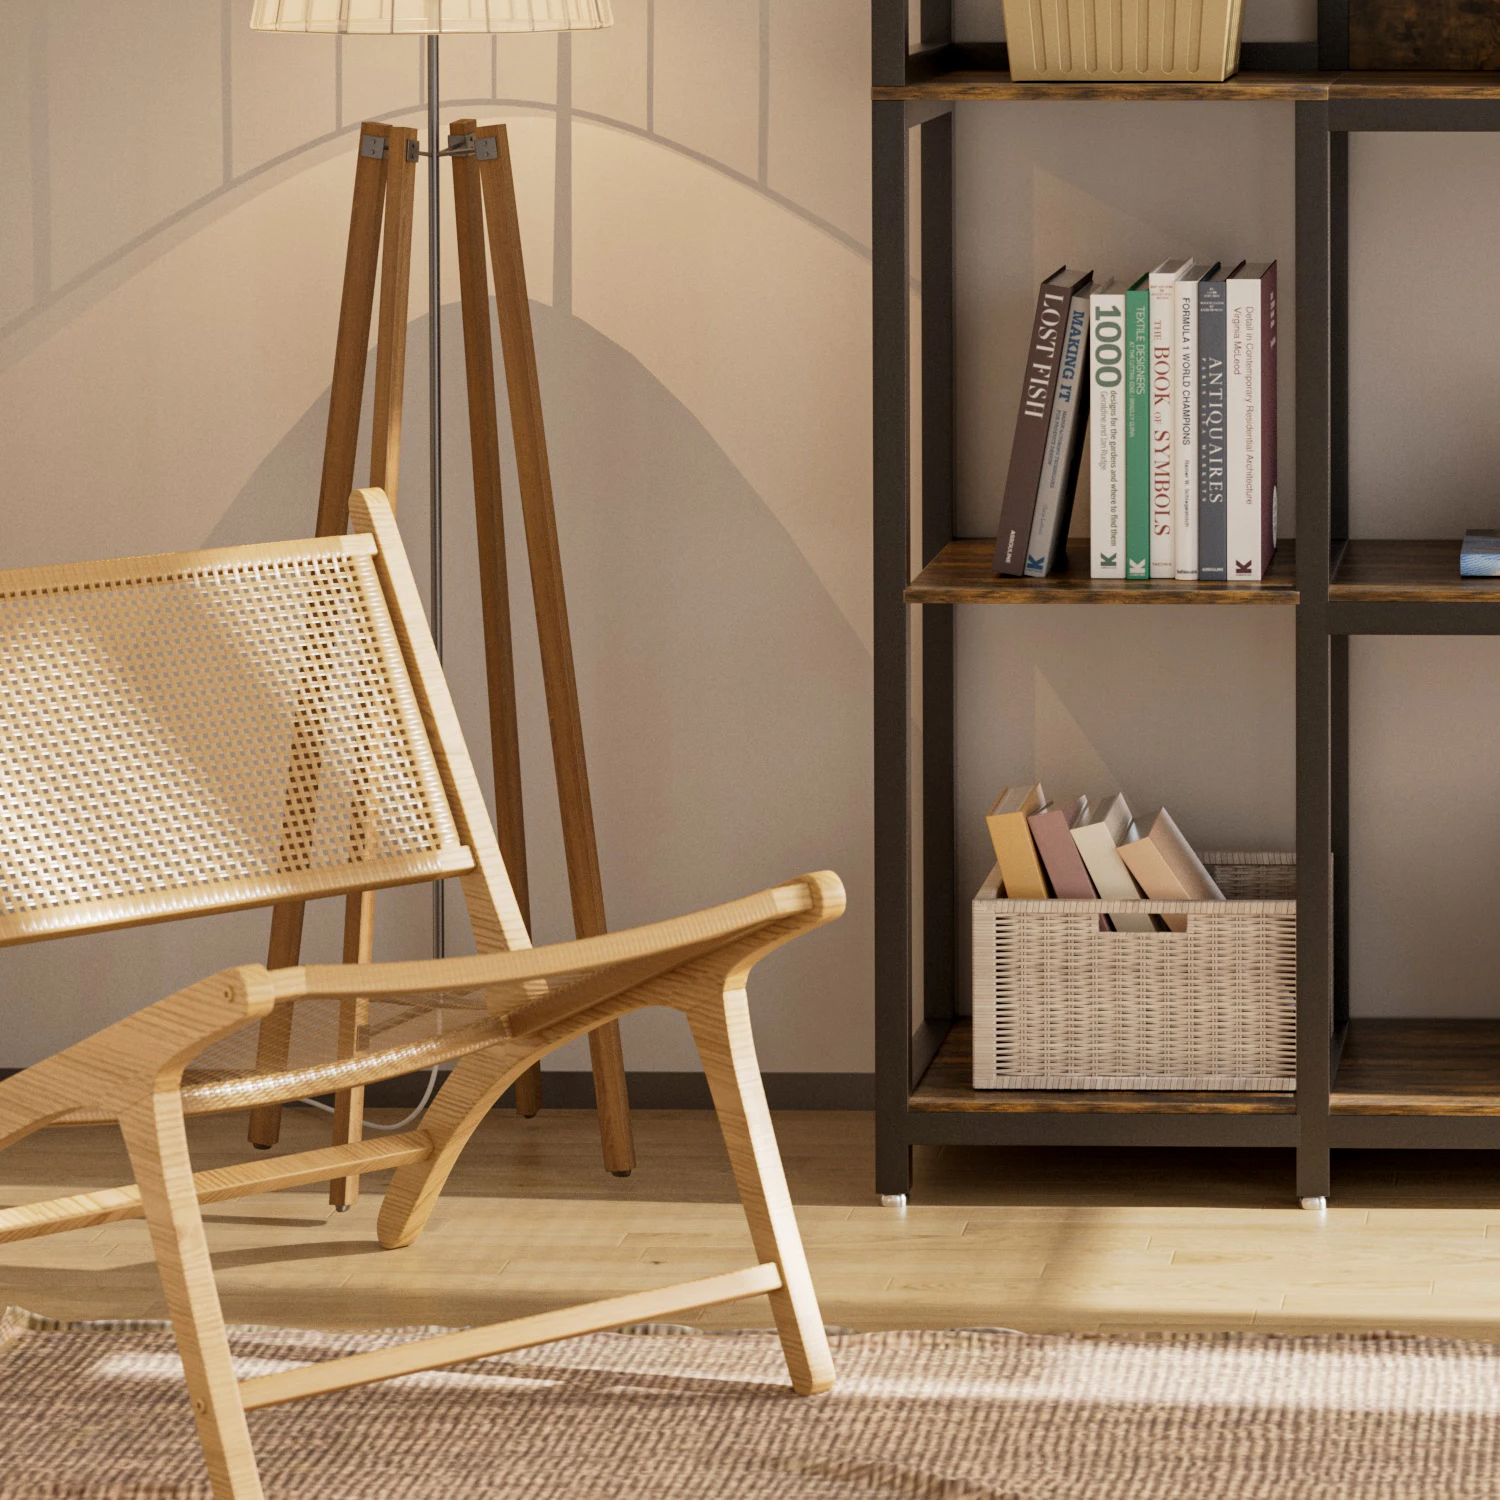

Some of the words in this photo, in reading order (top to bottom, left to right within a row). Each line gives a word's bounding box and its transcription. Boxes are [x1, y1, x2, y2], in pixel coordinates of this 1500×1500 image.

[1036, 293, 1064, 358] LOST
[1135, 305, 1146, 341] TEXTILE
[1154, 320, 1162, 340] THE
[1182, 297, 1190, 343] FORMULA
[1232, 307, 1241, 339] Virginia
[1245, 306, 1254, 331] Detail
[1062, 310, 1085, 380] MAKING
[1095, 305, 1122, 388] 1000
[1246, 333, 1253, 341] in
[1135, 343, 1146, 395] DESIGNERS
[1154, 347, 1170, 405] BOOK
[1182, 353, 1190, 389] WORLD
[1233, 341, 1242, 375] McLeod
[1244, 342, 1254, 404] Contemporary
[1024, 363, 1052, 418] FISH
[1058, 384, 1072, 403] IT
[1109, 390, 1117, 416] designs
[1154, 411, 1162, 424] OF
[1182, 390, 1191, 445] CHAMPIONS
[1206, 357, 1223, 503] ANTIQUAIRES
[1245, 405, 1254, 453] Residential
[1109, 441, 1118, 468] gardens
[1110, 484, 1118, 504] where
[1154, 430, 1171, 536] SYMBOLS
[1245, 454, 1254, 505] Architecture
[1110, 514, 1119, 530] find
[1110, 531, 1118, 546] them
